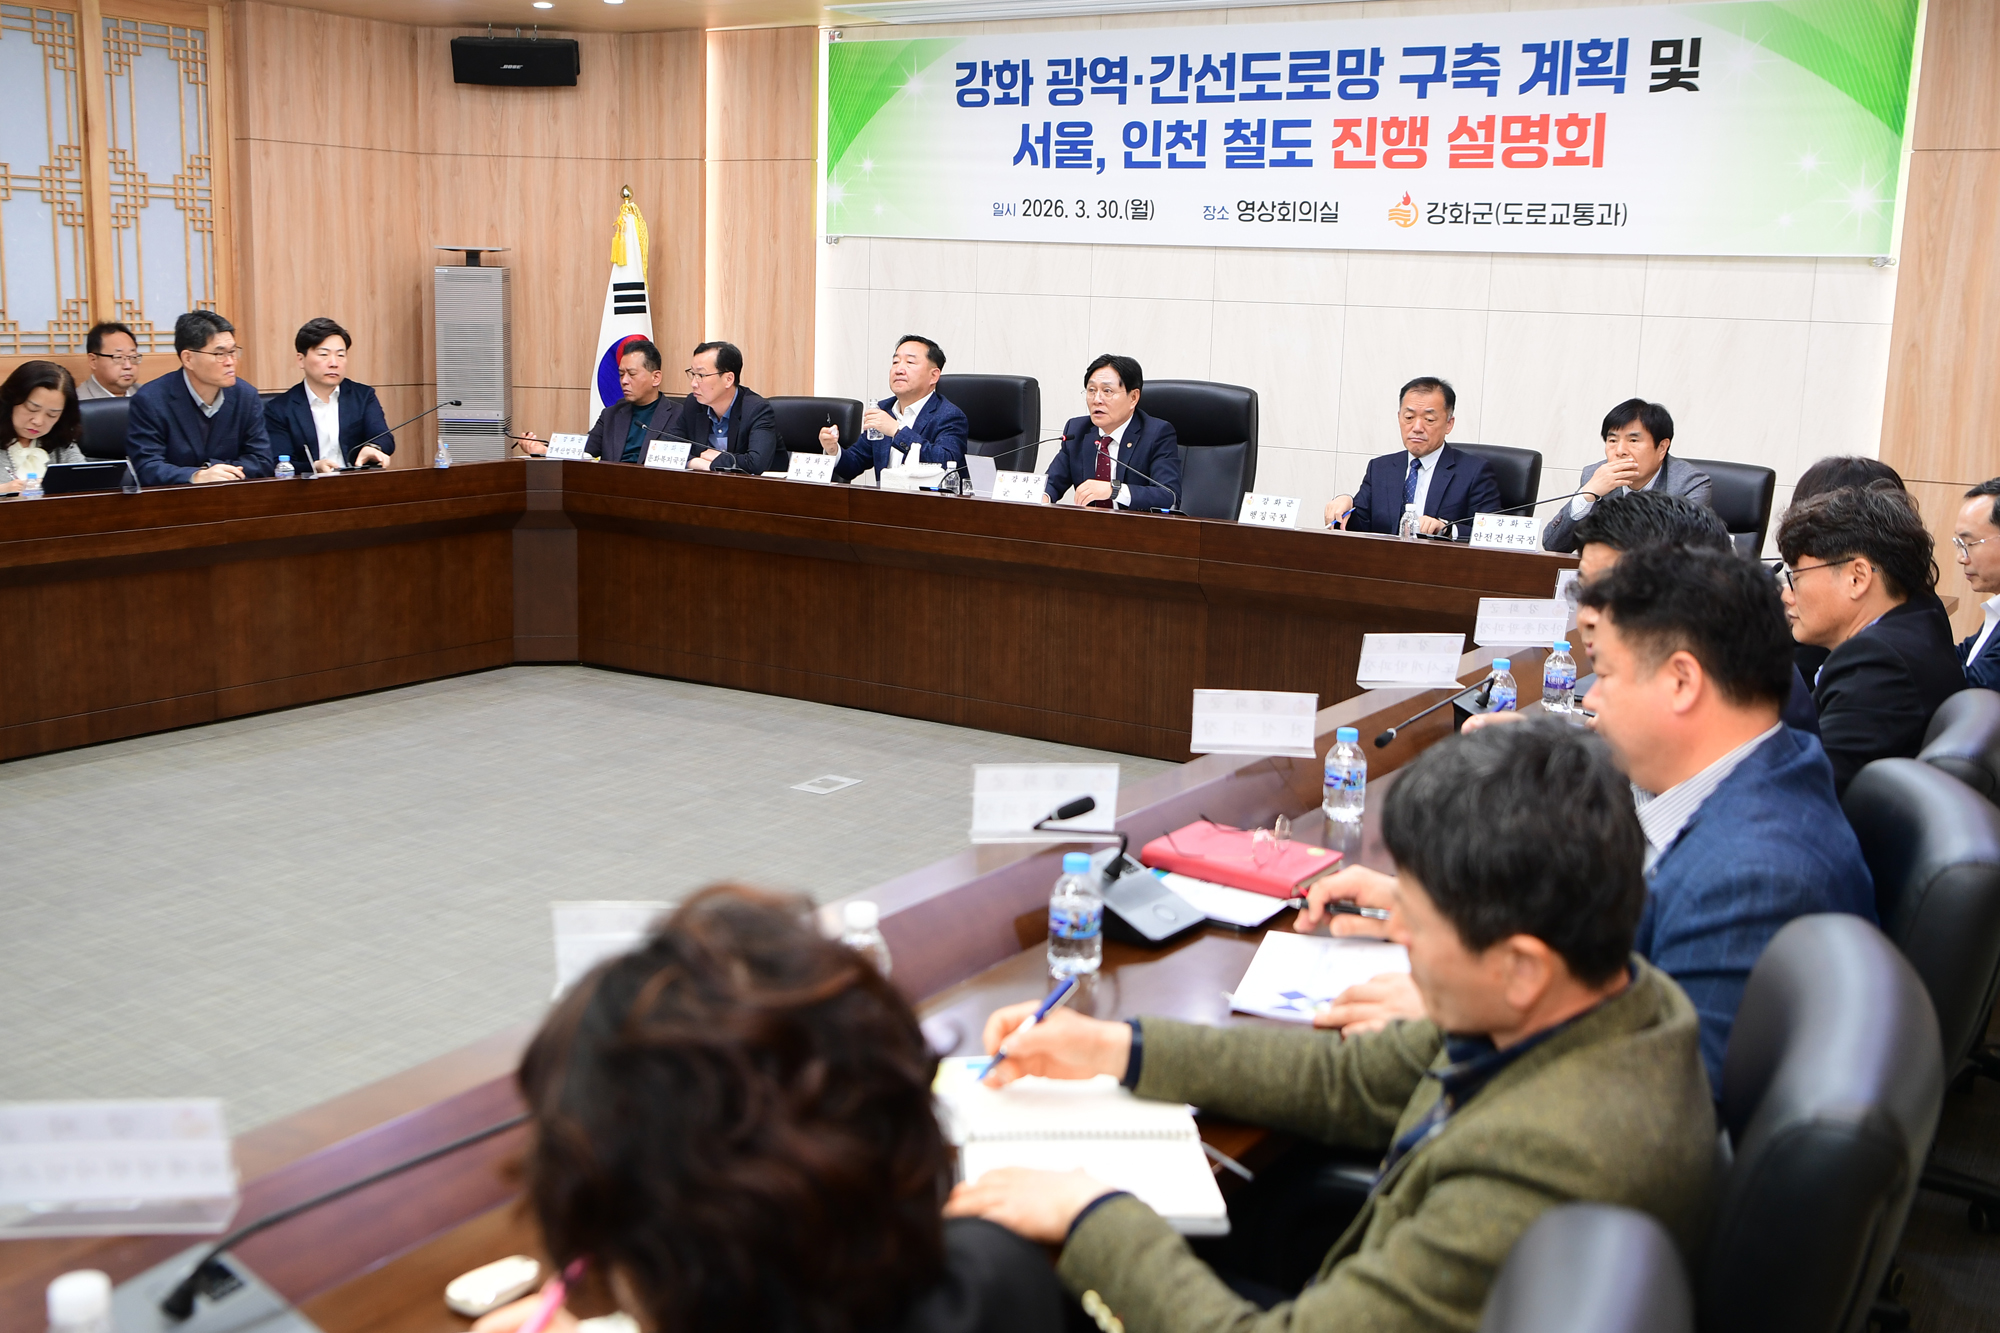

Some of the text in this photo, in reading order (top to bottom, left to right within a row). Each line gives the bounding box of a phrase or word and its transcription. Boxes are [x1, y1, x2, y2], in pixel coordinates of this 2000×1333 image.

[954, 36, 1703, 108] 강화 광역·간선도로망 구축 계획 및
[1012, 112, 1607, 176] 서울, 인천 철도 진행 설명회
[992, 198, 1155, 221] 일시 2026. 3. 30.(월)
[1203, 199, 1339, 224] 장소 영상회의실
[1426, 201, 1628, 227] 강화군(도로교통과)
